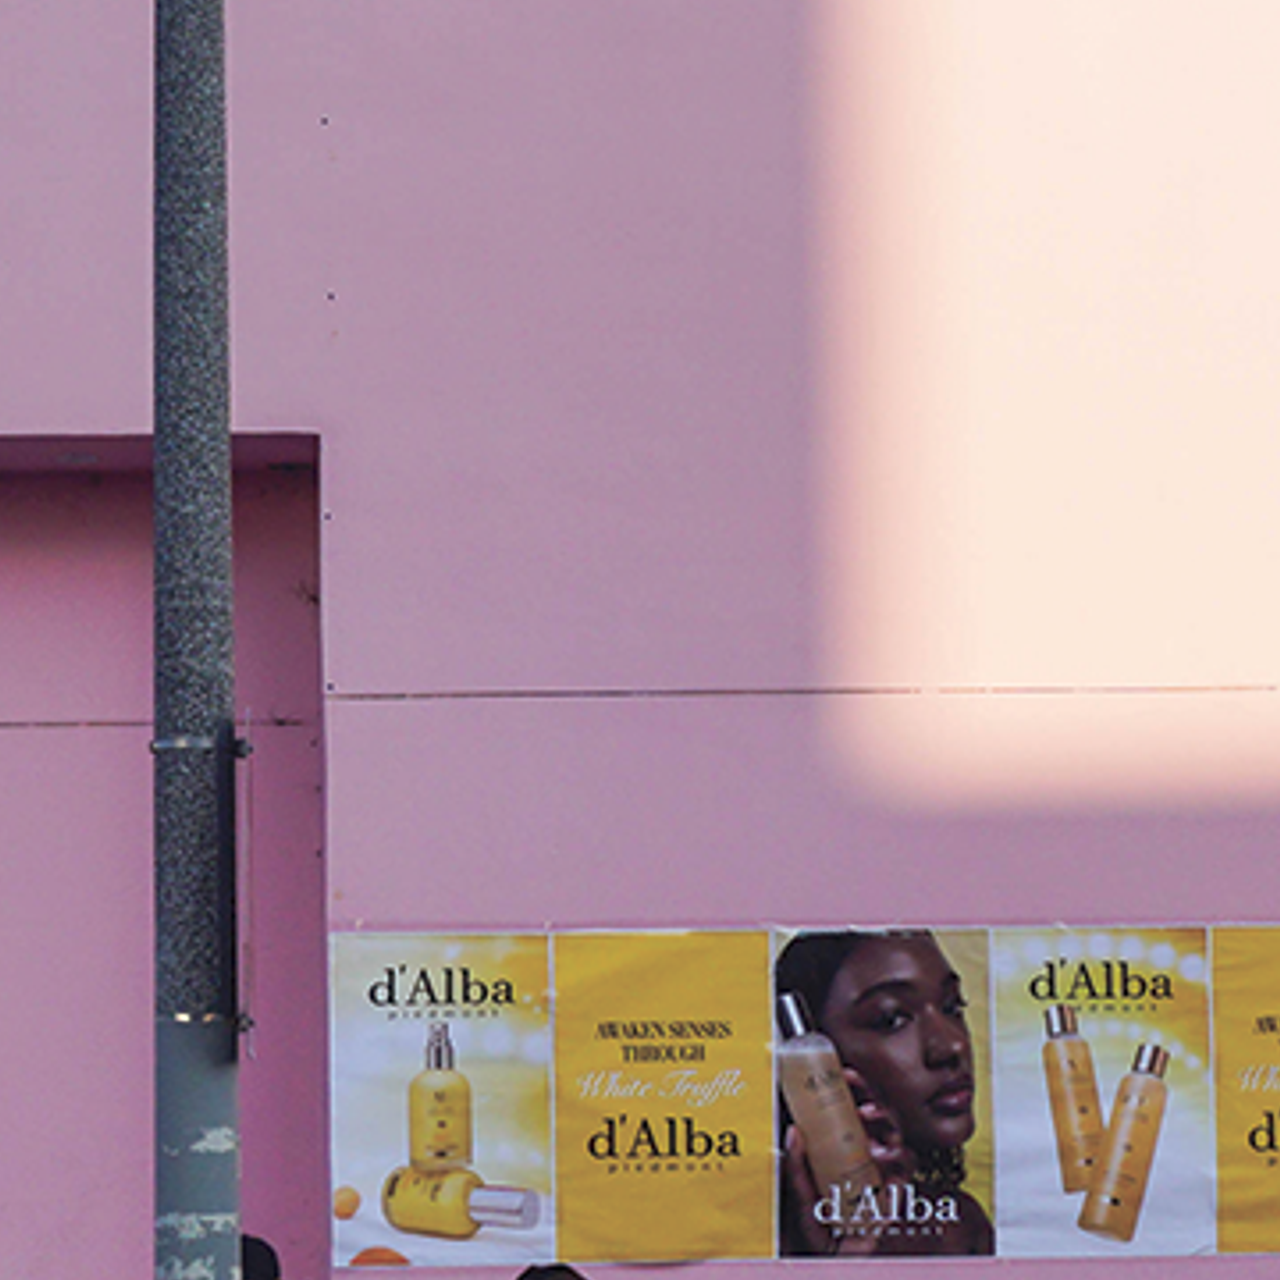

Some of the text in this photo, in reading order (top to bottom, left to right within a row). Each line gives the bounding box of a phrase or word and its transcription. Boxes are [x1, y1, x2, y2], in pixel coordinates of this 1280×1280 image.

[368, 966, 516, 1006] d'Alba
[1029, 958, 1174, 1000] d'Alba
[621, 1045, 706, 1062] THROUGH
[587, 1114, 742, 1158] d'Alba
[813, 1181, 960, 1225] d'Alba
